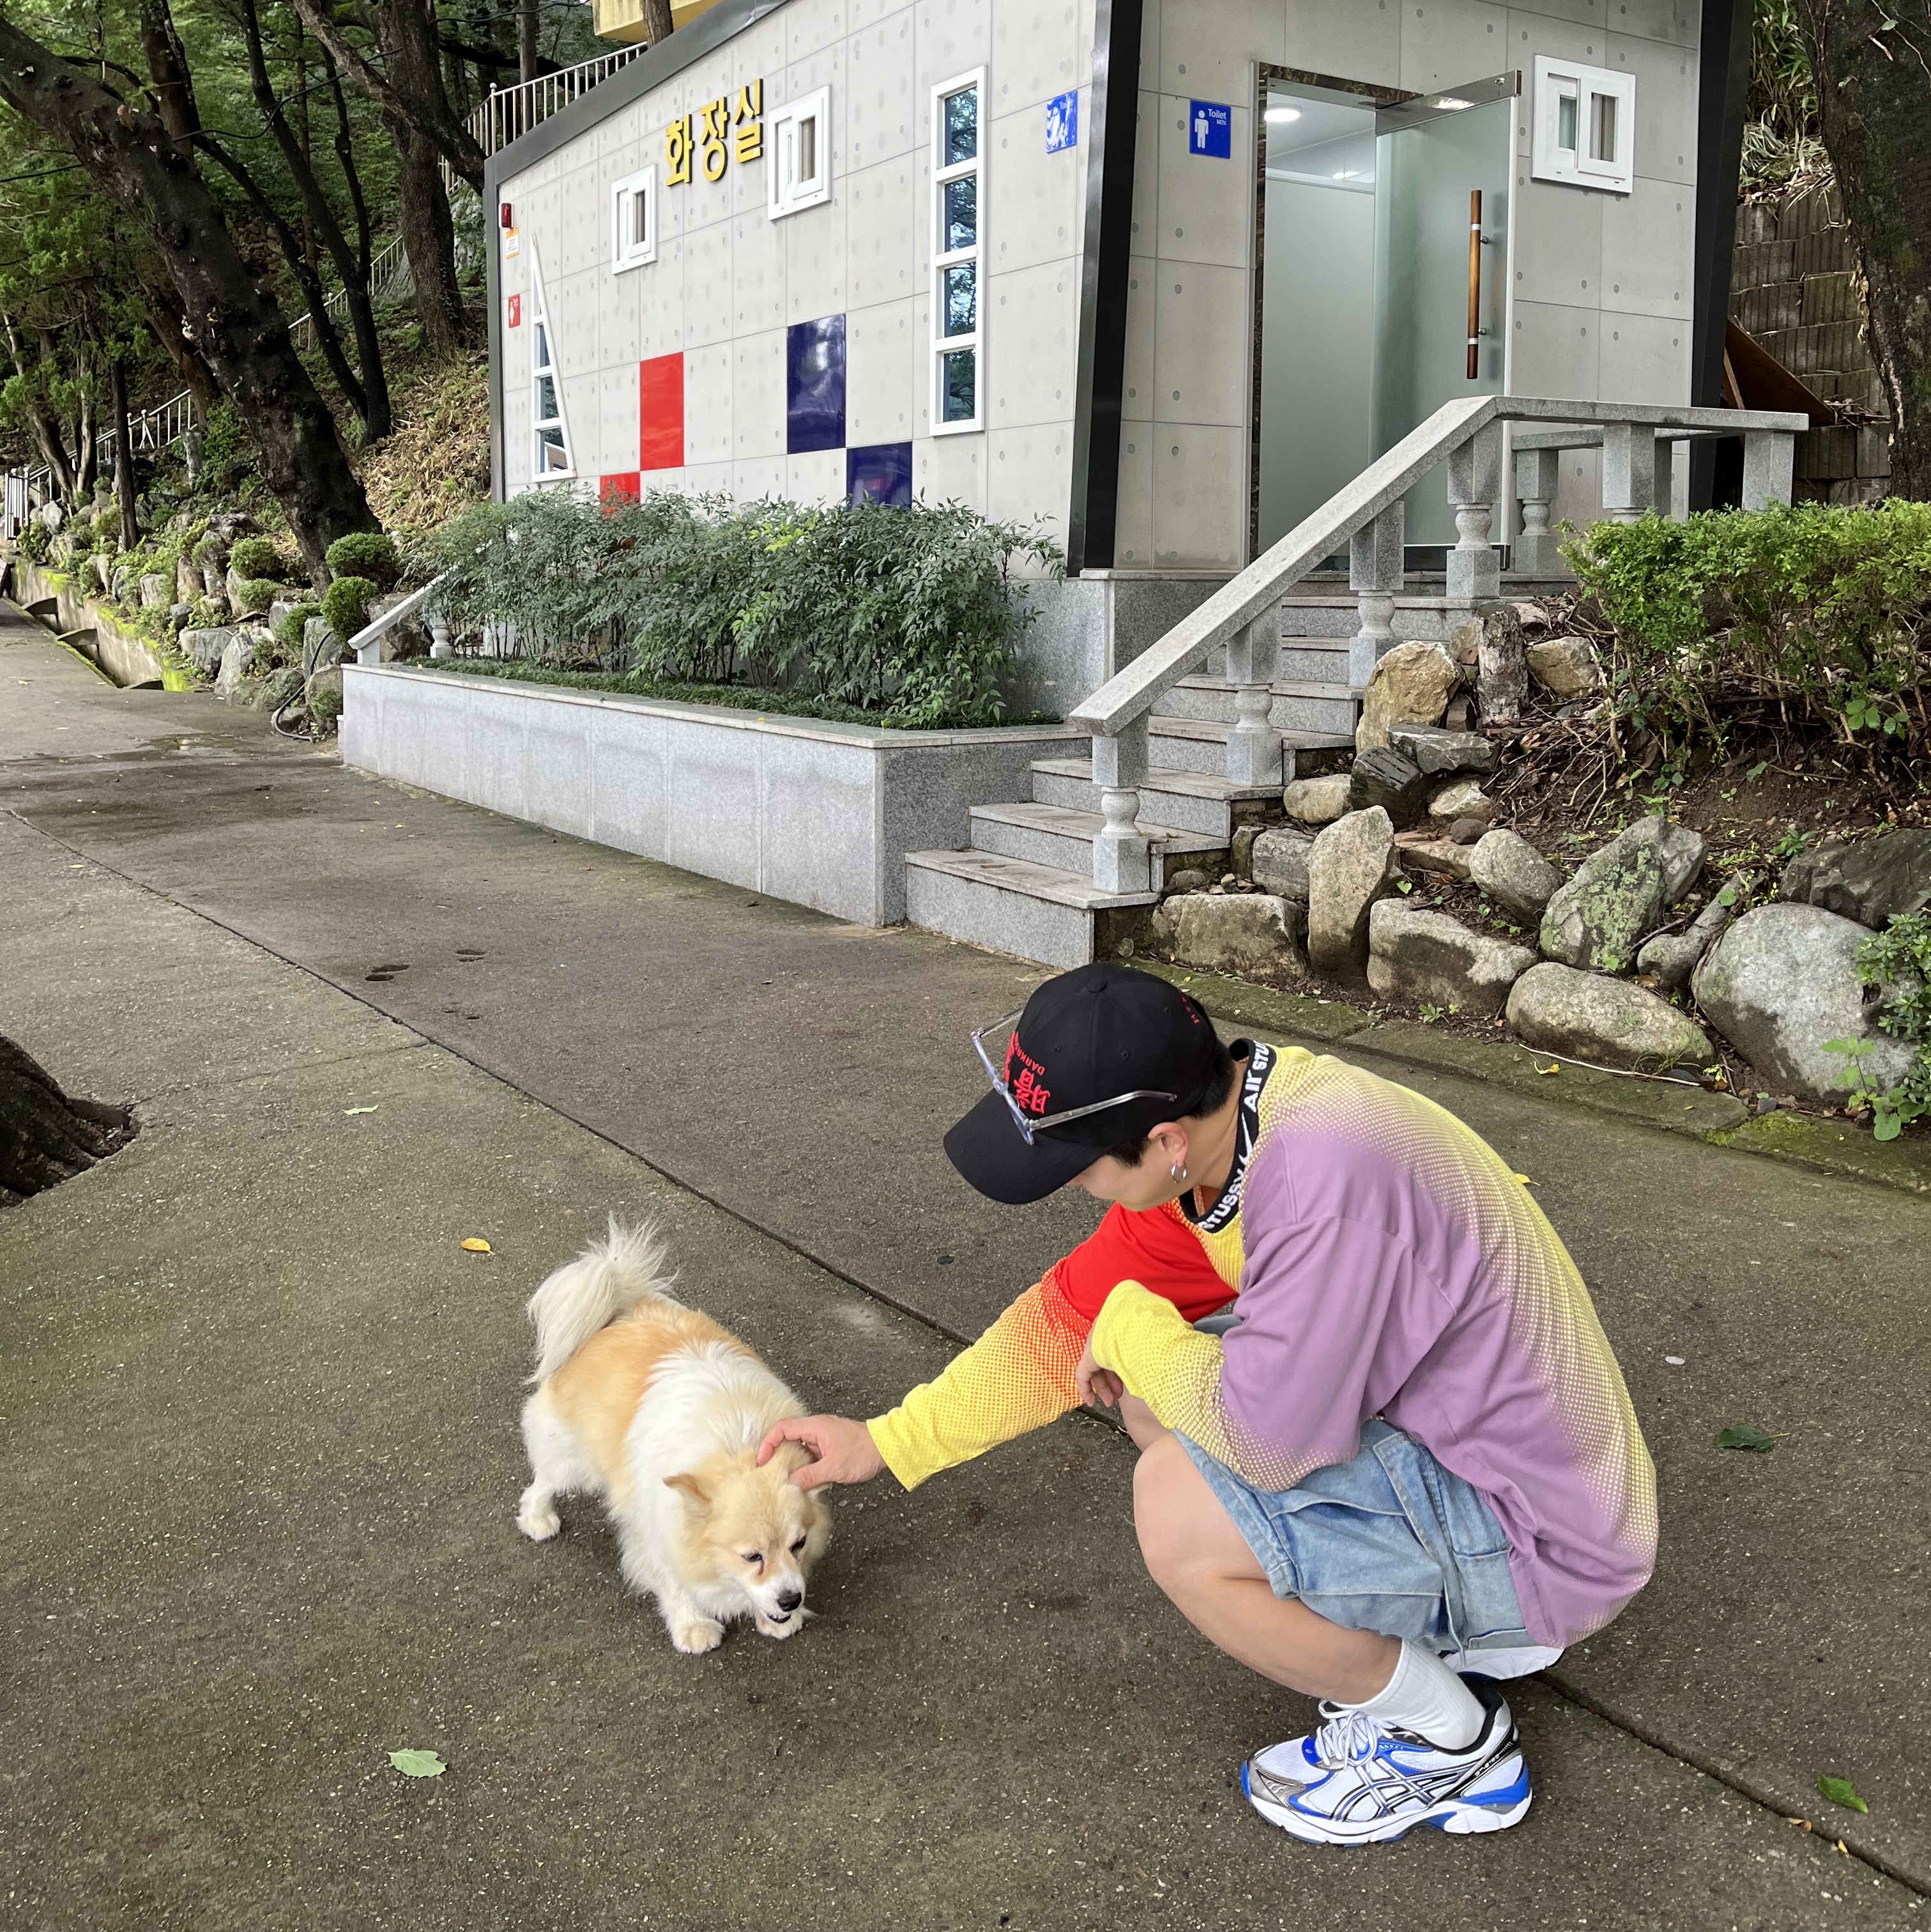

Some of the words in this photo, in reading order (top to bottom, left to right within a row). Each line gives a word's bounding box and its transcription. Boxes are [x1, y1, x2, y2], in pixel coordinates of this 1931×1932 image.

[1207, 108, 1226, 120] Toilet
[666, 79, 764, 187] 화장실
[1252, 1039, 1269, 1070] STU
